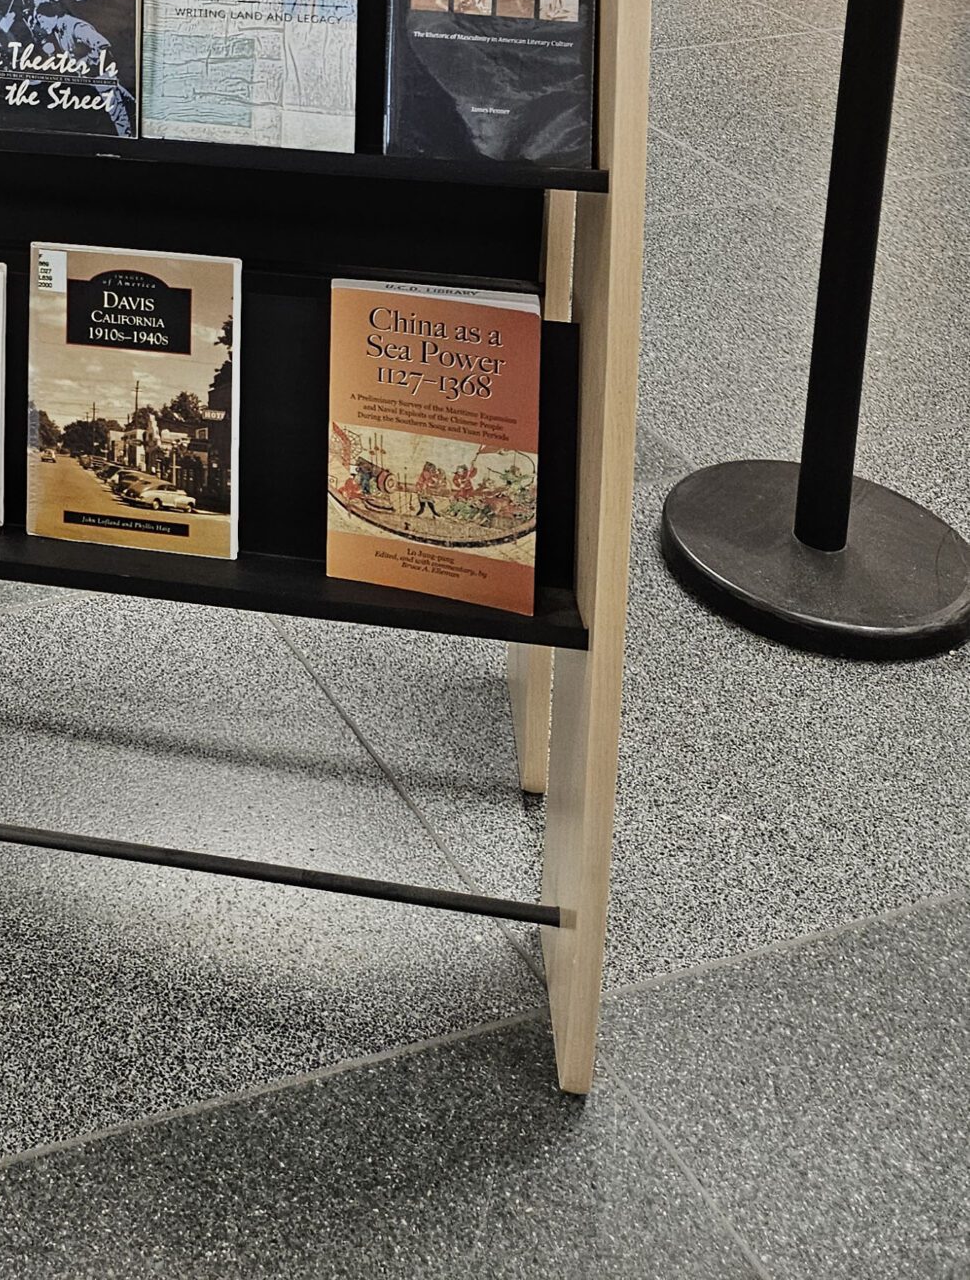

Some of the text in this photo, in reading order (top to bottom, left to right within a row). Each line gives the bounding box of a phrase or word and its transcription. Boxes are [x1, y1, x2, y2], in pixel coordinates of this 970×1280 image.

[175, 8, 343, 24] WRITING LAND AND LEGACY
[450, 32, 457, 40] of
[498, 36, 527, 45] American
[527, 38, 551, 47] Literary
[551, 39, 574, 47] Culture
[7, 42, 91, 75] Theater
[98, 49, 119, 78] Is
[4, 79, 41, 106] the
[47, 81, 115, 112] Street
[117, 279, 156, 289] America
[385, 283, 479, 296] U.C.D. LIBRARY
[369, 306, 504, 348] China as a
[366, 334, 506, 376] Sea Power
[377, 367, 493, 402] 1127–1368
[358, 393, 398, 406] Preliminary
[399, 399, 423, 410] Survey
[432, 403, 445, 412] the
[357, 411, 462, 433] During the Southern Song and
[363, 404, 377, 412] and
[377, 405, 398, 415] Naval
[399, 408, 427, 419] Exploits
[428, 411, 436, 419] of
[436, 412, 450, 421] the
[82, 515, 96, 523] John
[121, 519, 133, 528] and
[134, 521, 155, 531] Phyllis
